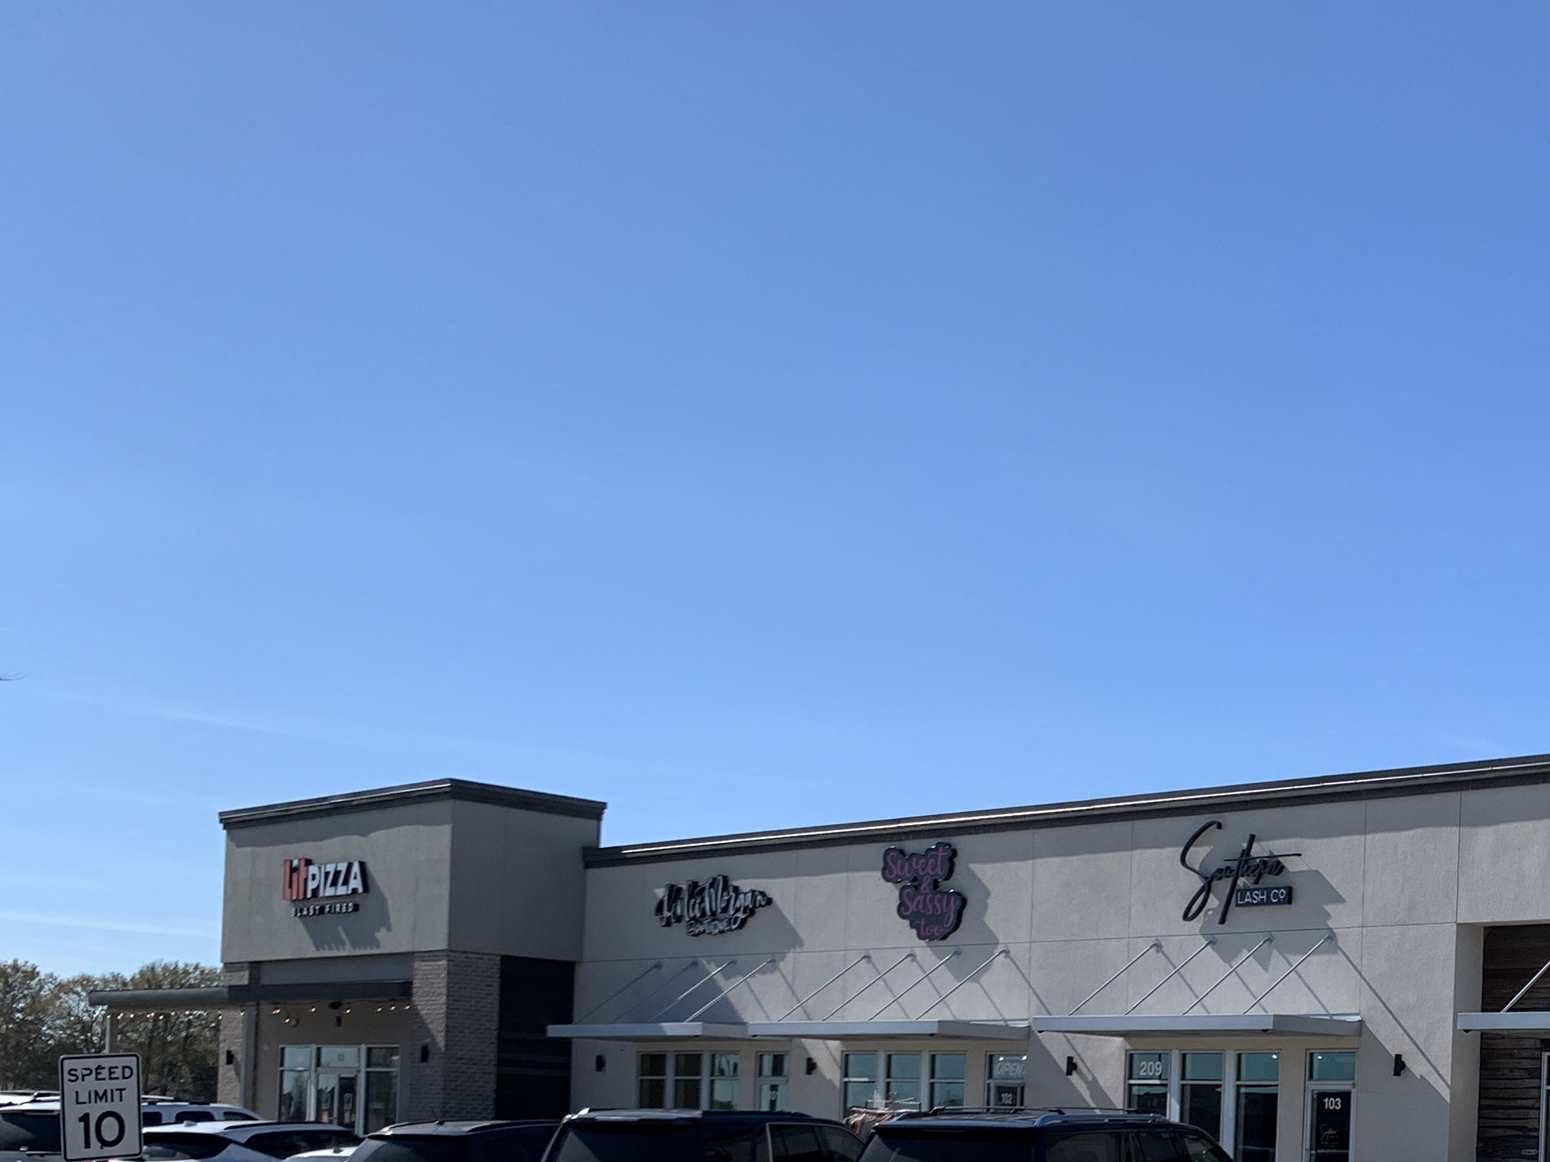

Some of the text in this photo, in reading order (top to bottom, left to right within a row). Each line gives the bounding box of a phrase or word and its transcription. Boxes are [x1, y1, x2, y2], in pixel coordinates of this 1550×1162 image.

[887, 847, 948, 878] Sweet
[306, 860, 364, 899] PIZZA
[1237, 889, 1267, 905] LASH
[902, 889, 956, 928] Sassy
[67, 1065, 134, 1083] SPEED
[1140, 1061, 1162, 1076] 209
[75, 1087, 127, 1105] LIMIT
[1323, 1097, 1341, 1110] 103
[78, 1110, 126, 1150] 10
